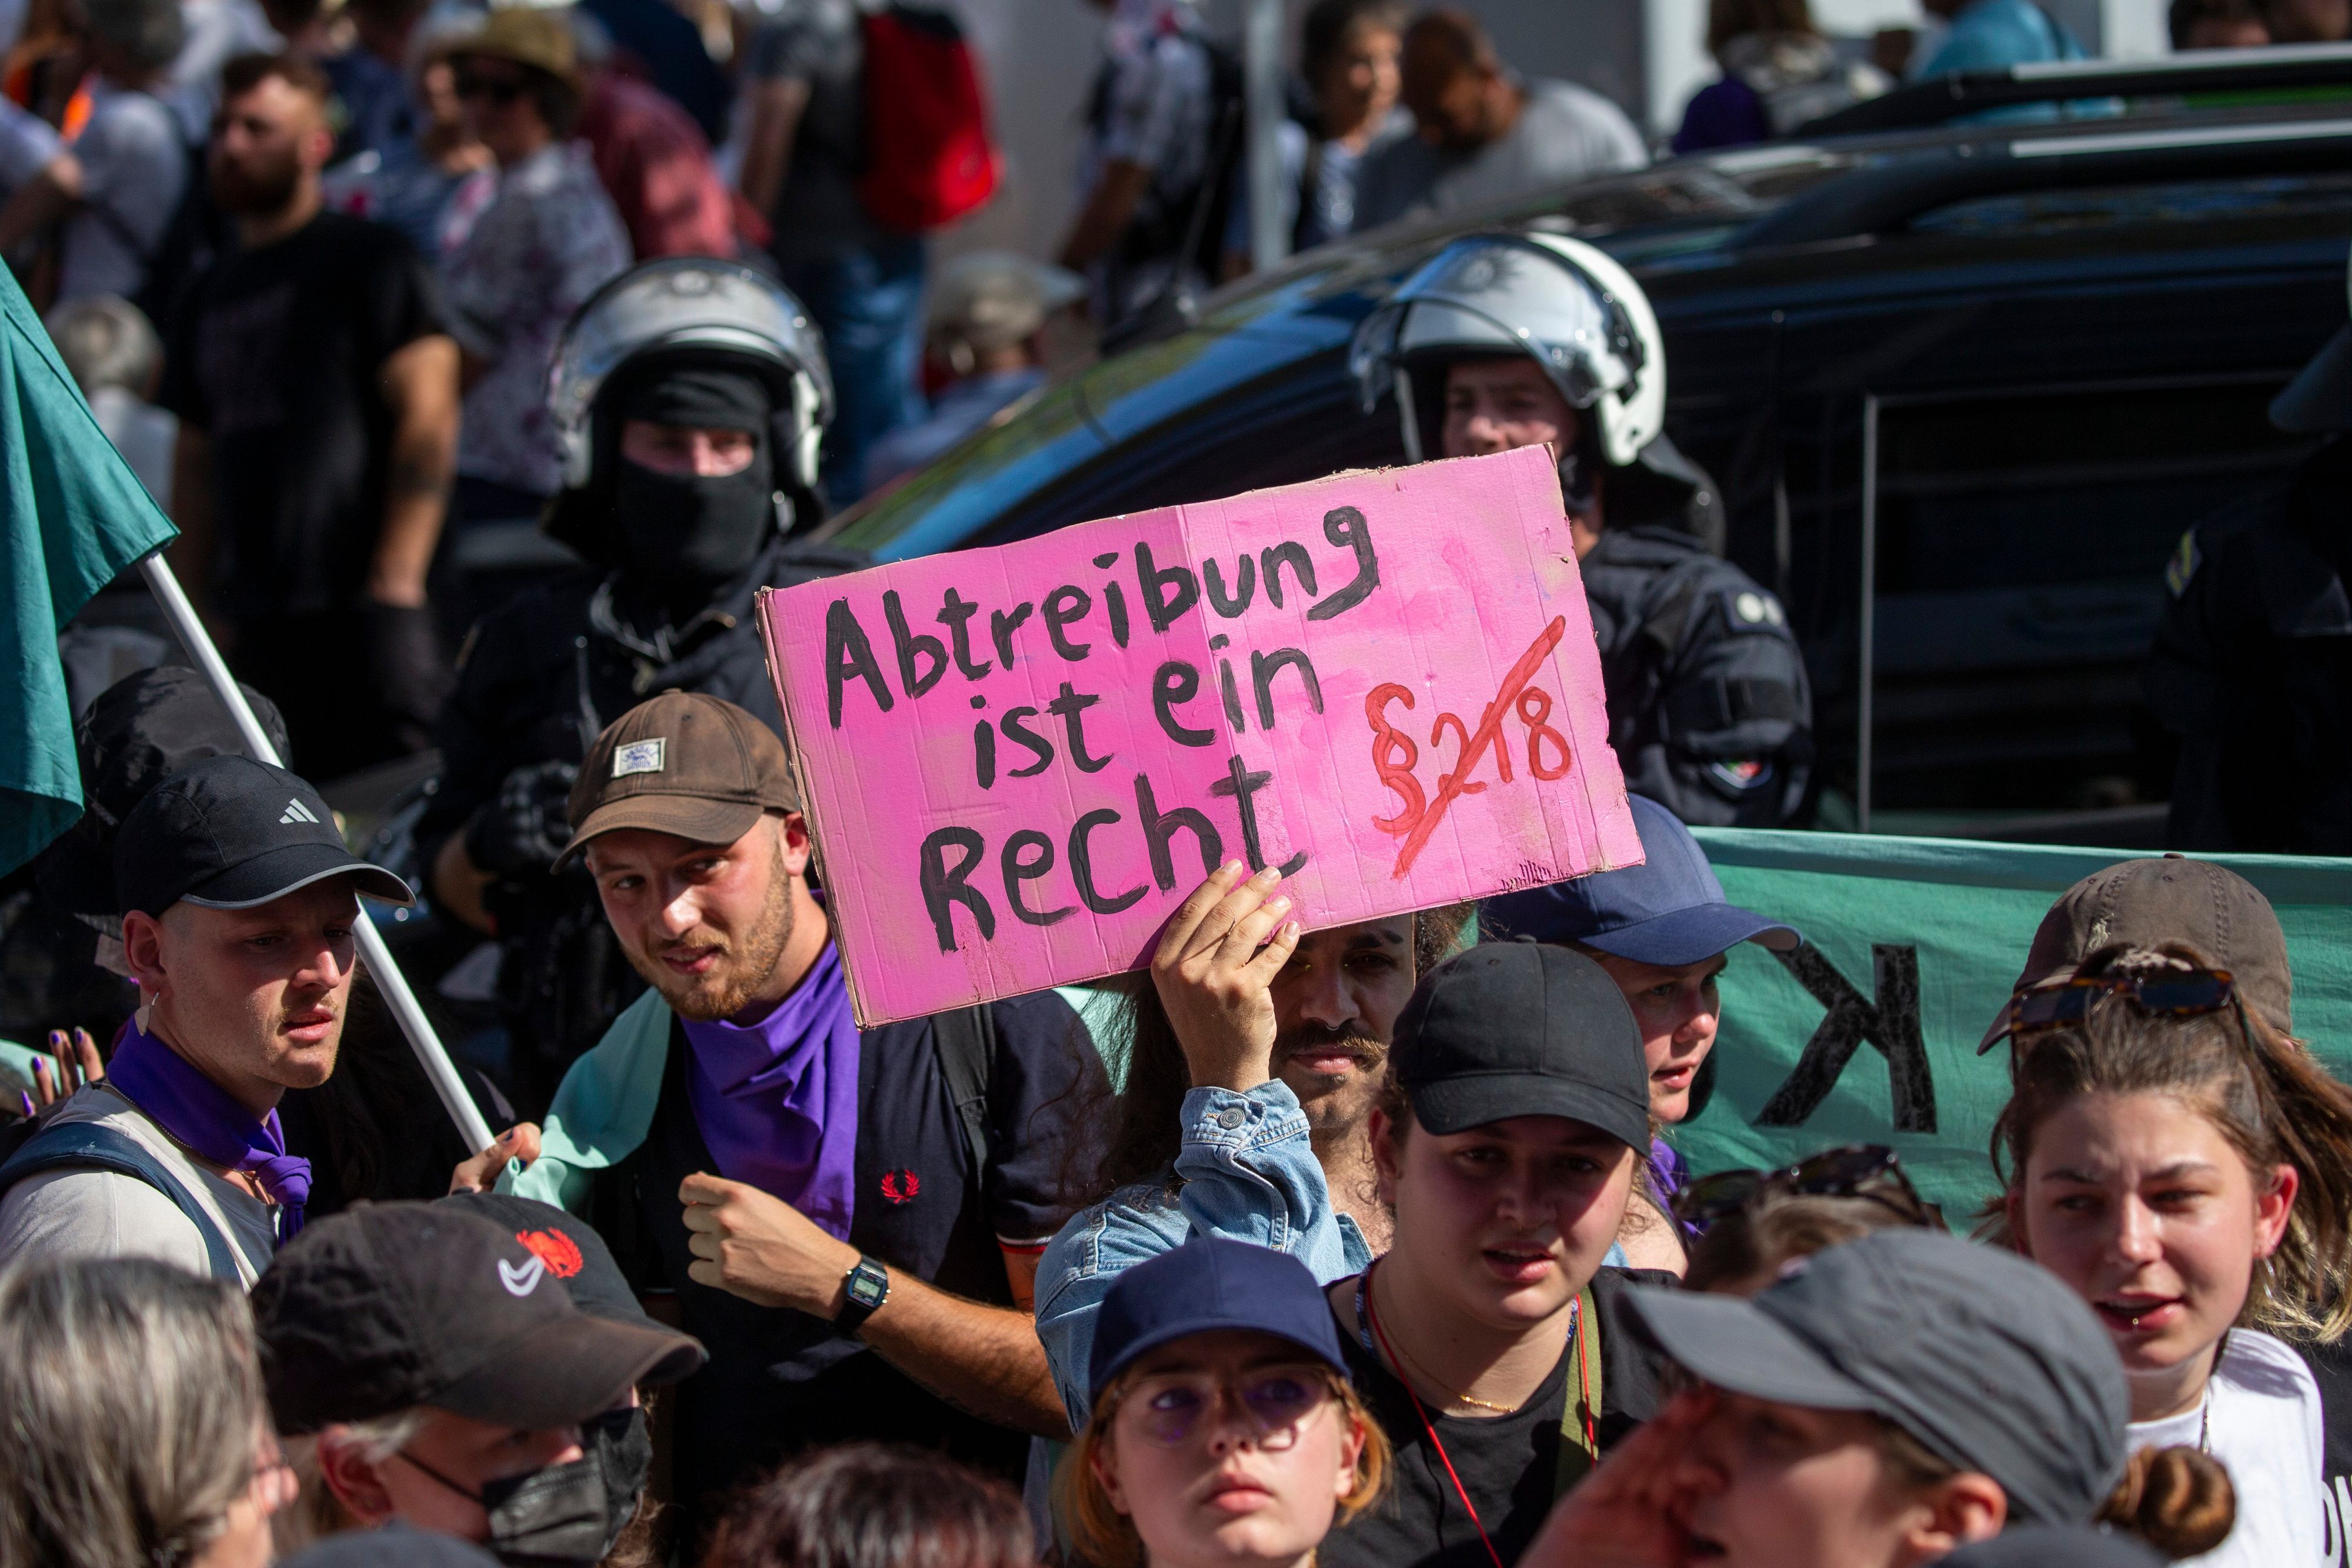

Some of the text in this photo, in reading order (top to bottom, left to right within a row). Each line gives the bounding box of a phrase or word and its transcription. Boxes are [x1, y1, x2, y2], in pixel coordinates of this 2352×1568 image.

[825, 506, 1380, 729] Abtreibung
[970, 634, 1324, 790] ist ein
[920, 755, 1307, 954] Recht
